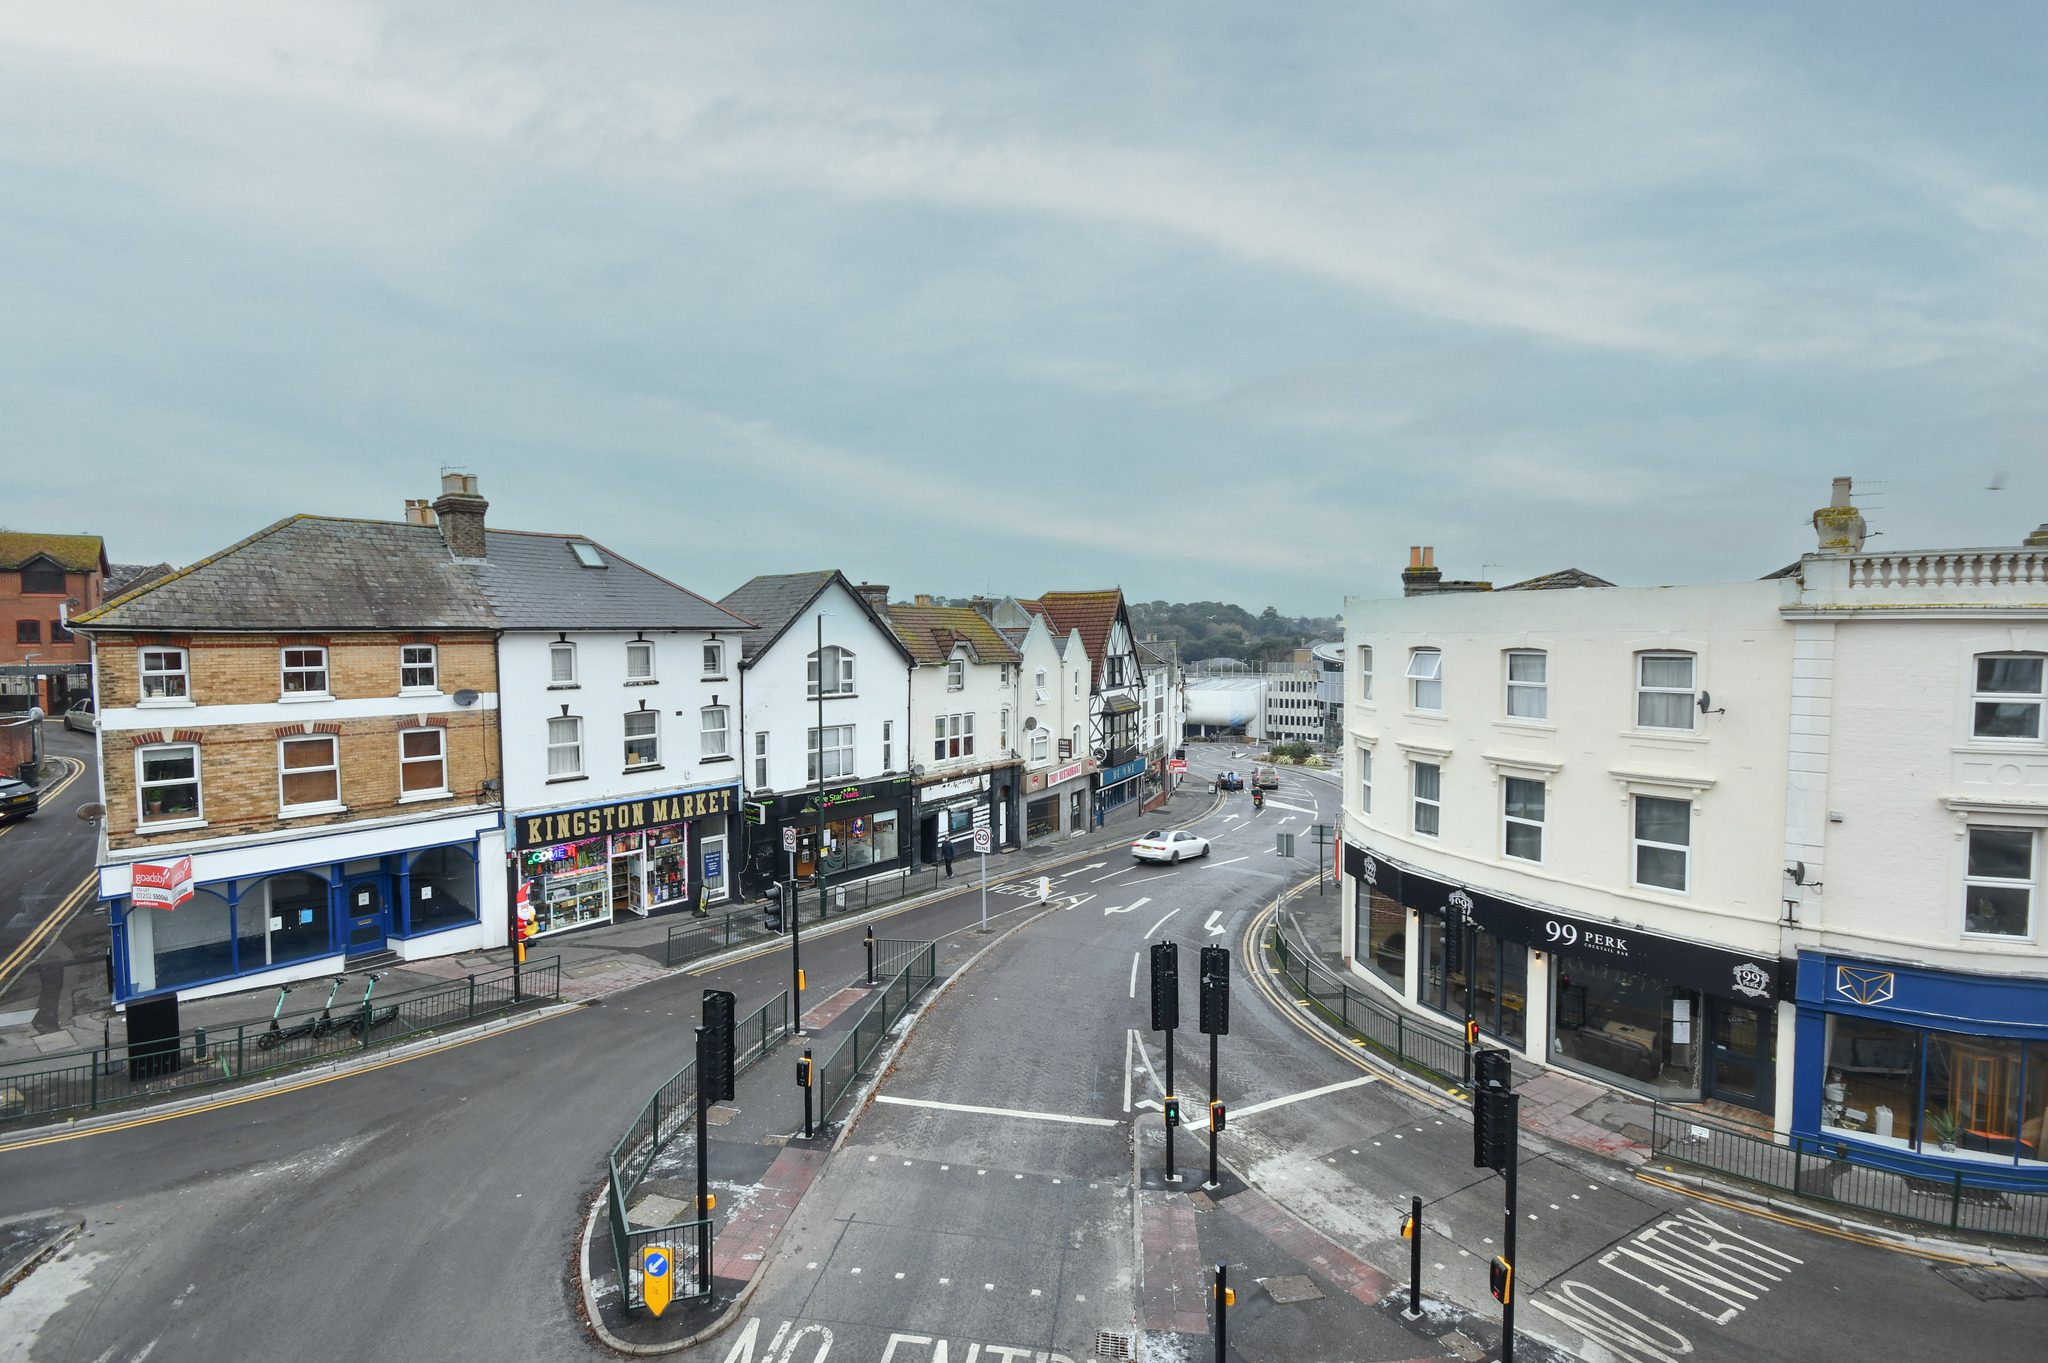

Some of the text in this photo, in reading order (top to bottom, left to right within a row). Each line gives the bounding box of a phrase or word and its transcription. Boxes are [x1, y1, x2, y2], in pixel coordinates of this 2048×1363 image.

[1049, 773, 1059, 785] TROY
[829, 792, 843, 802] Star
[843, 790, 859, 799] Nails
[528, 789, 731, 844] KINGSTON MARKET
[785, 833, 794, 841] 20
[977, 833, 988, 841] 20
[135, 872, 166, 886] goadsby
[1545, 920, 1628, 951] 99 PERK
[1583, 942, 1614, 954] COCKTAIL
[1742, 970, 1760, 983] 99
[1529, 1207, 1804, 1363] NO ENTRY
